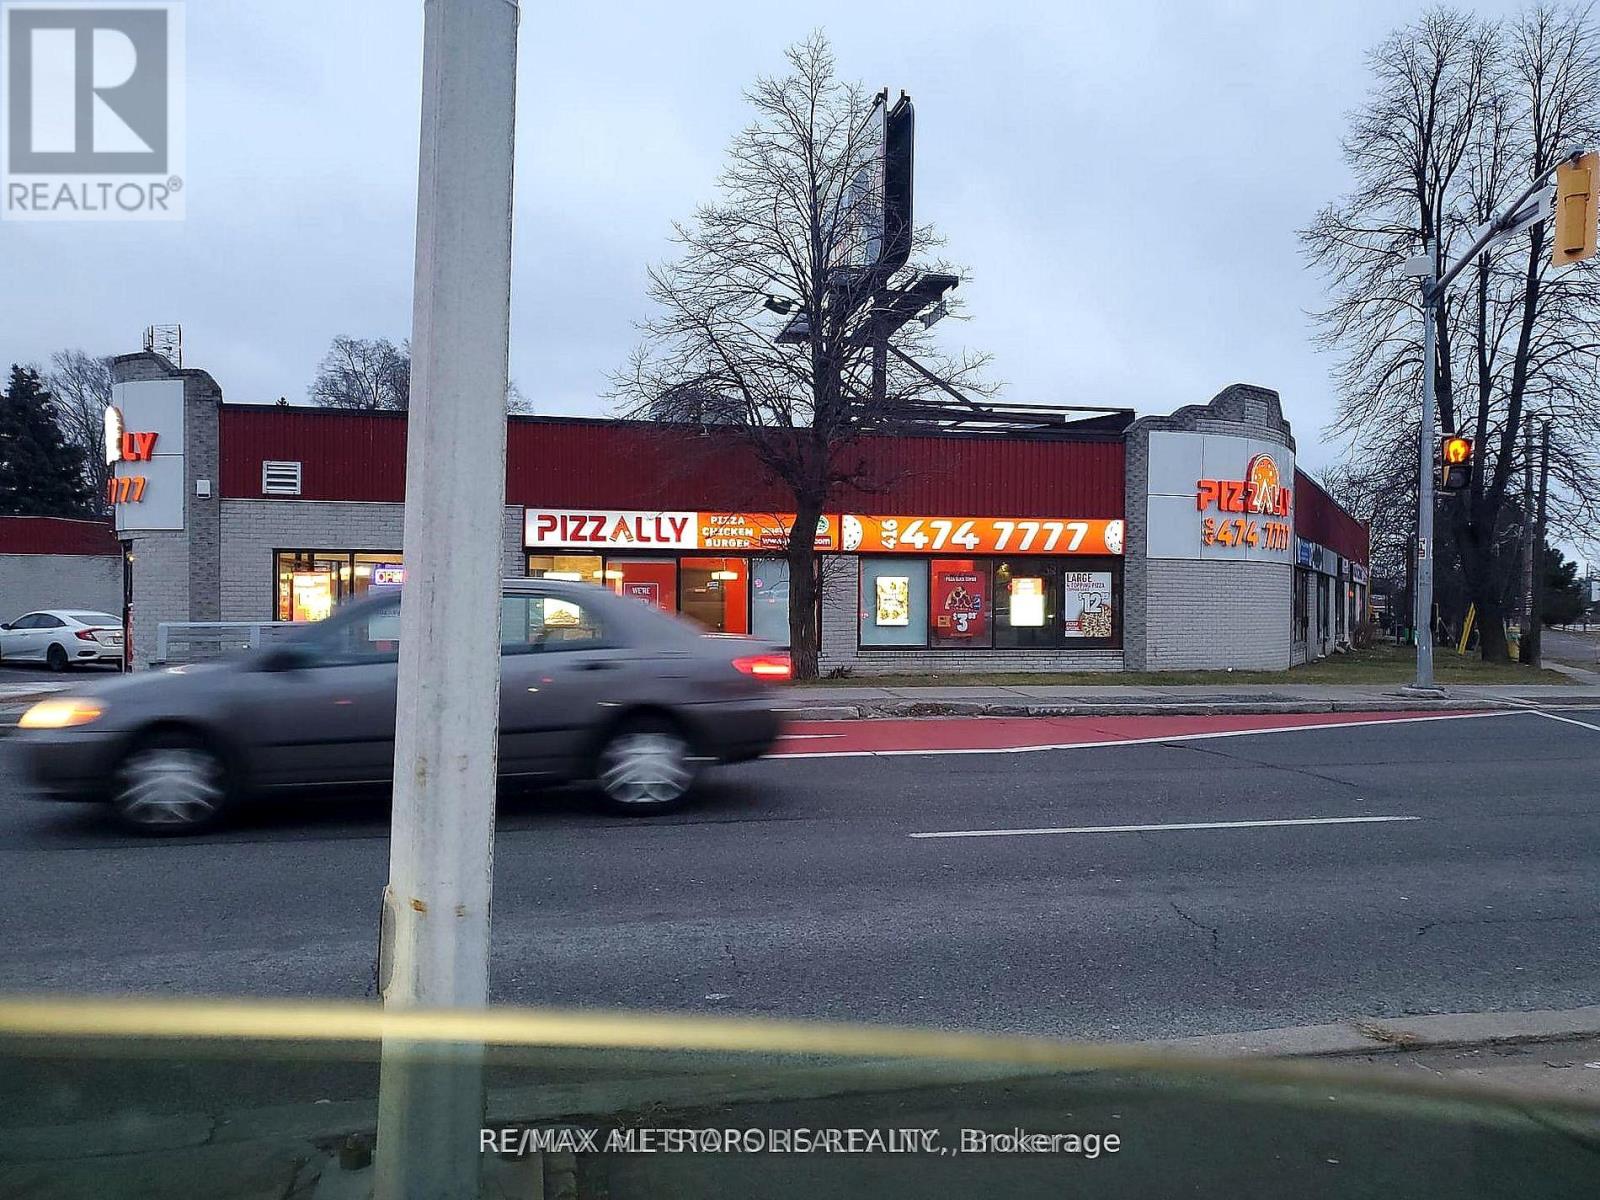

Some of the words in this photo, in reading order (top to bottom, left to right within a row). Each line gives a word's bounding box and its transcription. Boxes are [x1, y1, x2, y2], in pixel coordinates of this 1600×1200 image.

[710, 516, 745, 525] PIZZA
[537, 514, 689, 543] PIZZALLY
[702, 527, 753, 536] CHICKEN
[900, 519, 980, 550] 474
[992, 521, 1089, 551] 7777
[705, 538, 750, 547] BURGER
[1066, 573, 1093, 583] LARGE
